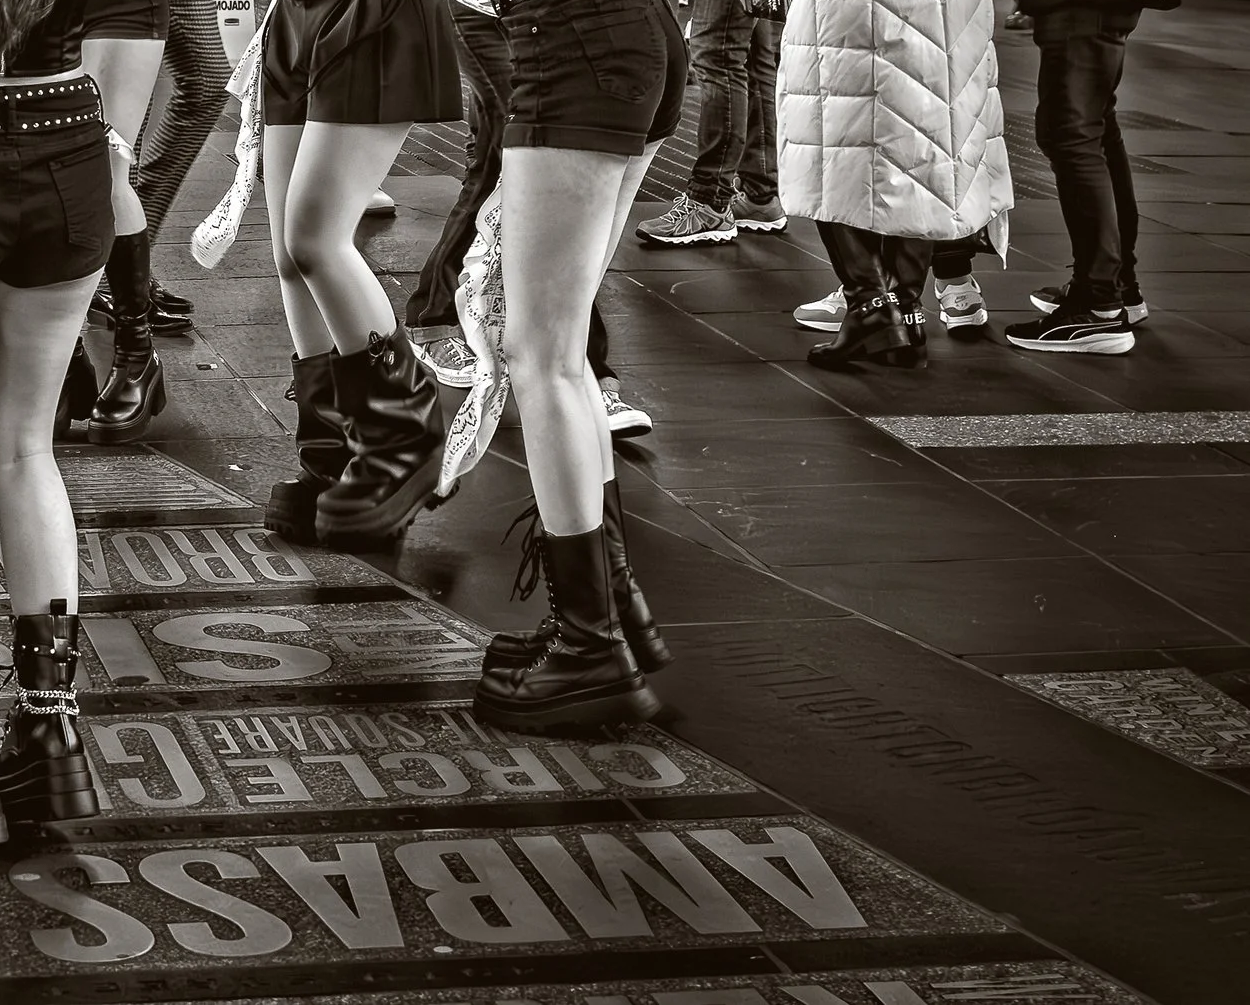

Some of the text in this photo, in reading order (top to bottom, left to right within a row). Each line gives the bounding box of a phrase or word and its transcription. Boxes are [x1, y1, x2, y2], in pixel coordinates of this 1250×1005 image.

[202, 711, 426, 754] SQUARE
[1141, 676, 1250, 752] WINTE
[223, 742, 687, 803] CIRCLE
